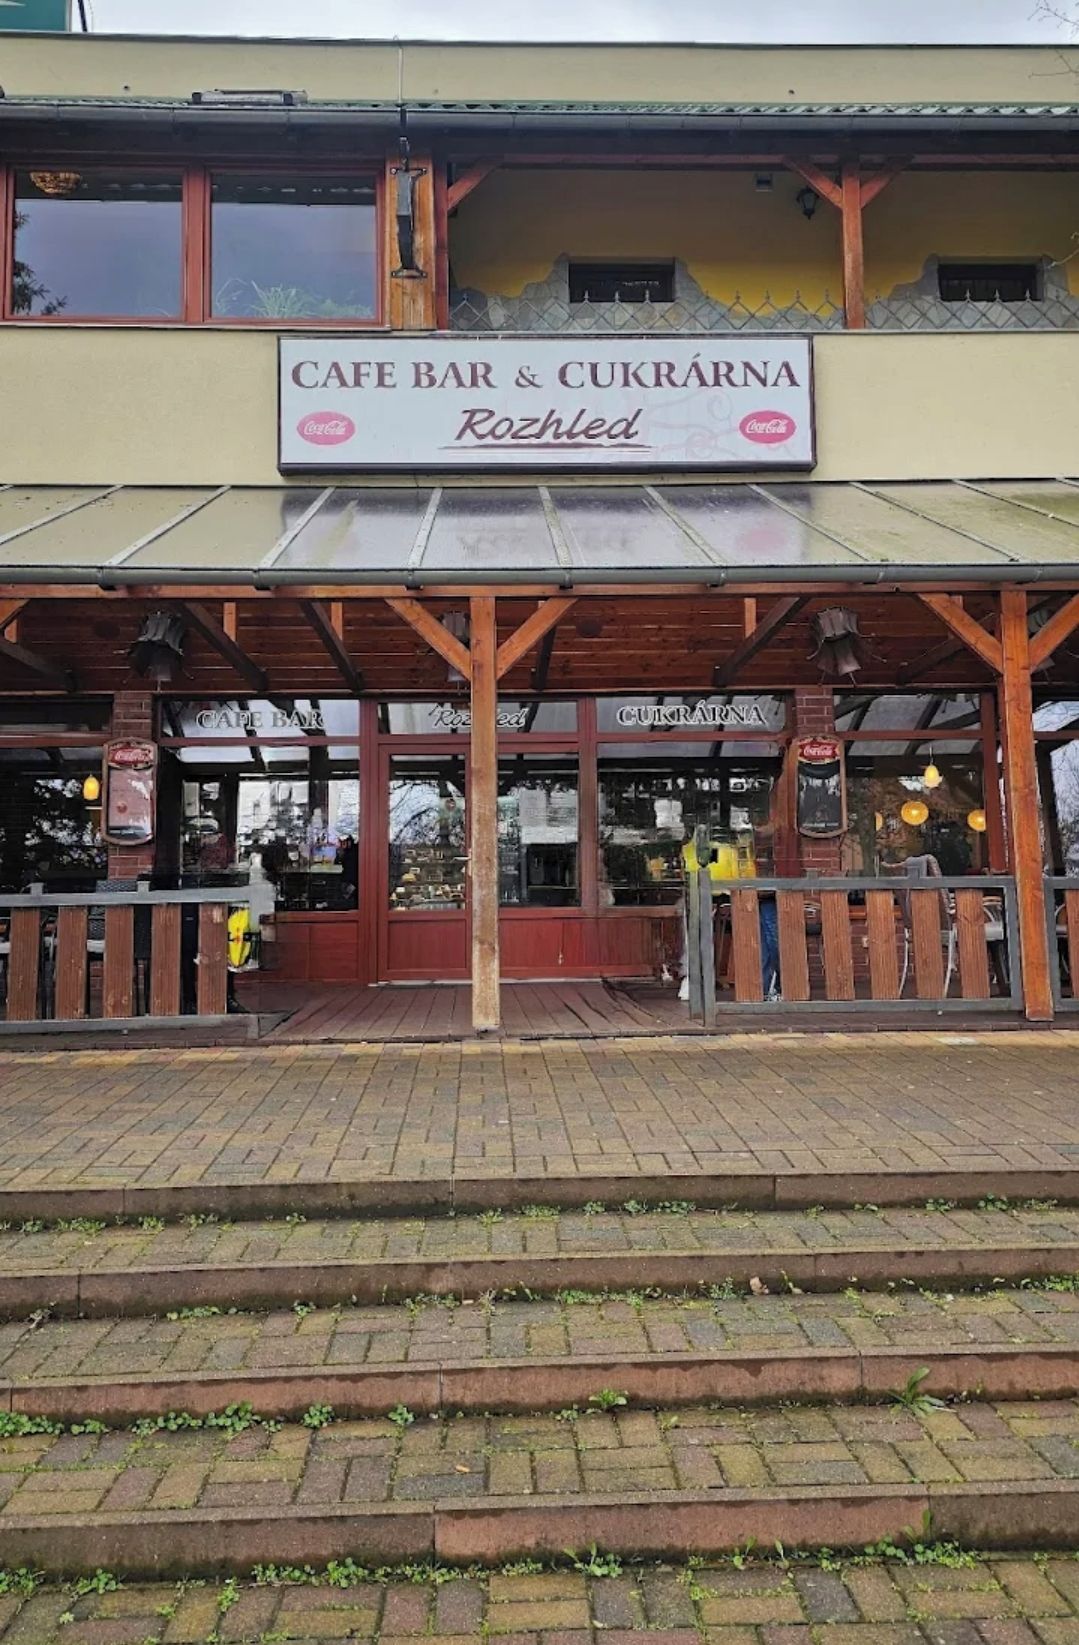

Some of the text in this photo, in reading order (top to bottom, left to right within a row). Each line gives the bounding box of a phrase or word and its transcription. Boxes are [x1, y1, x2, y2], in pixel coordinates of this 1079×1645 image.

[291, 352, 801, 389] CAFE BAR & CUKRÁRNA
[454, 407, 643, 440] Rozhled
[196, 709, 325, 730] CAFE BAR
[432, 708, 529, 728] Rozed
[616, 700, 769, 726] CUKRÁRNA
